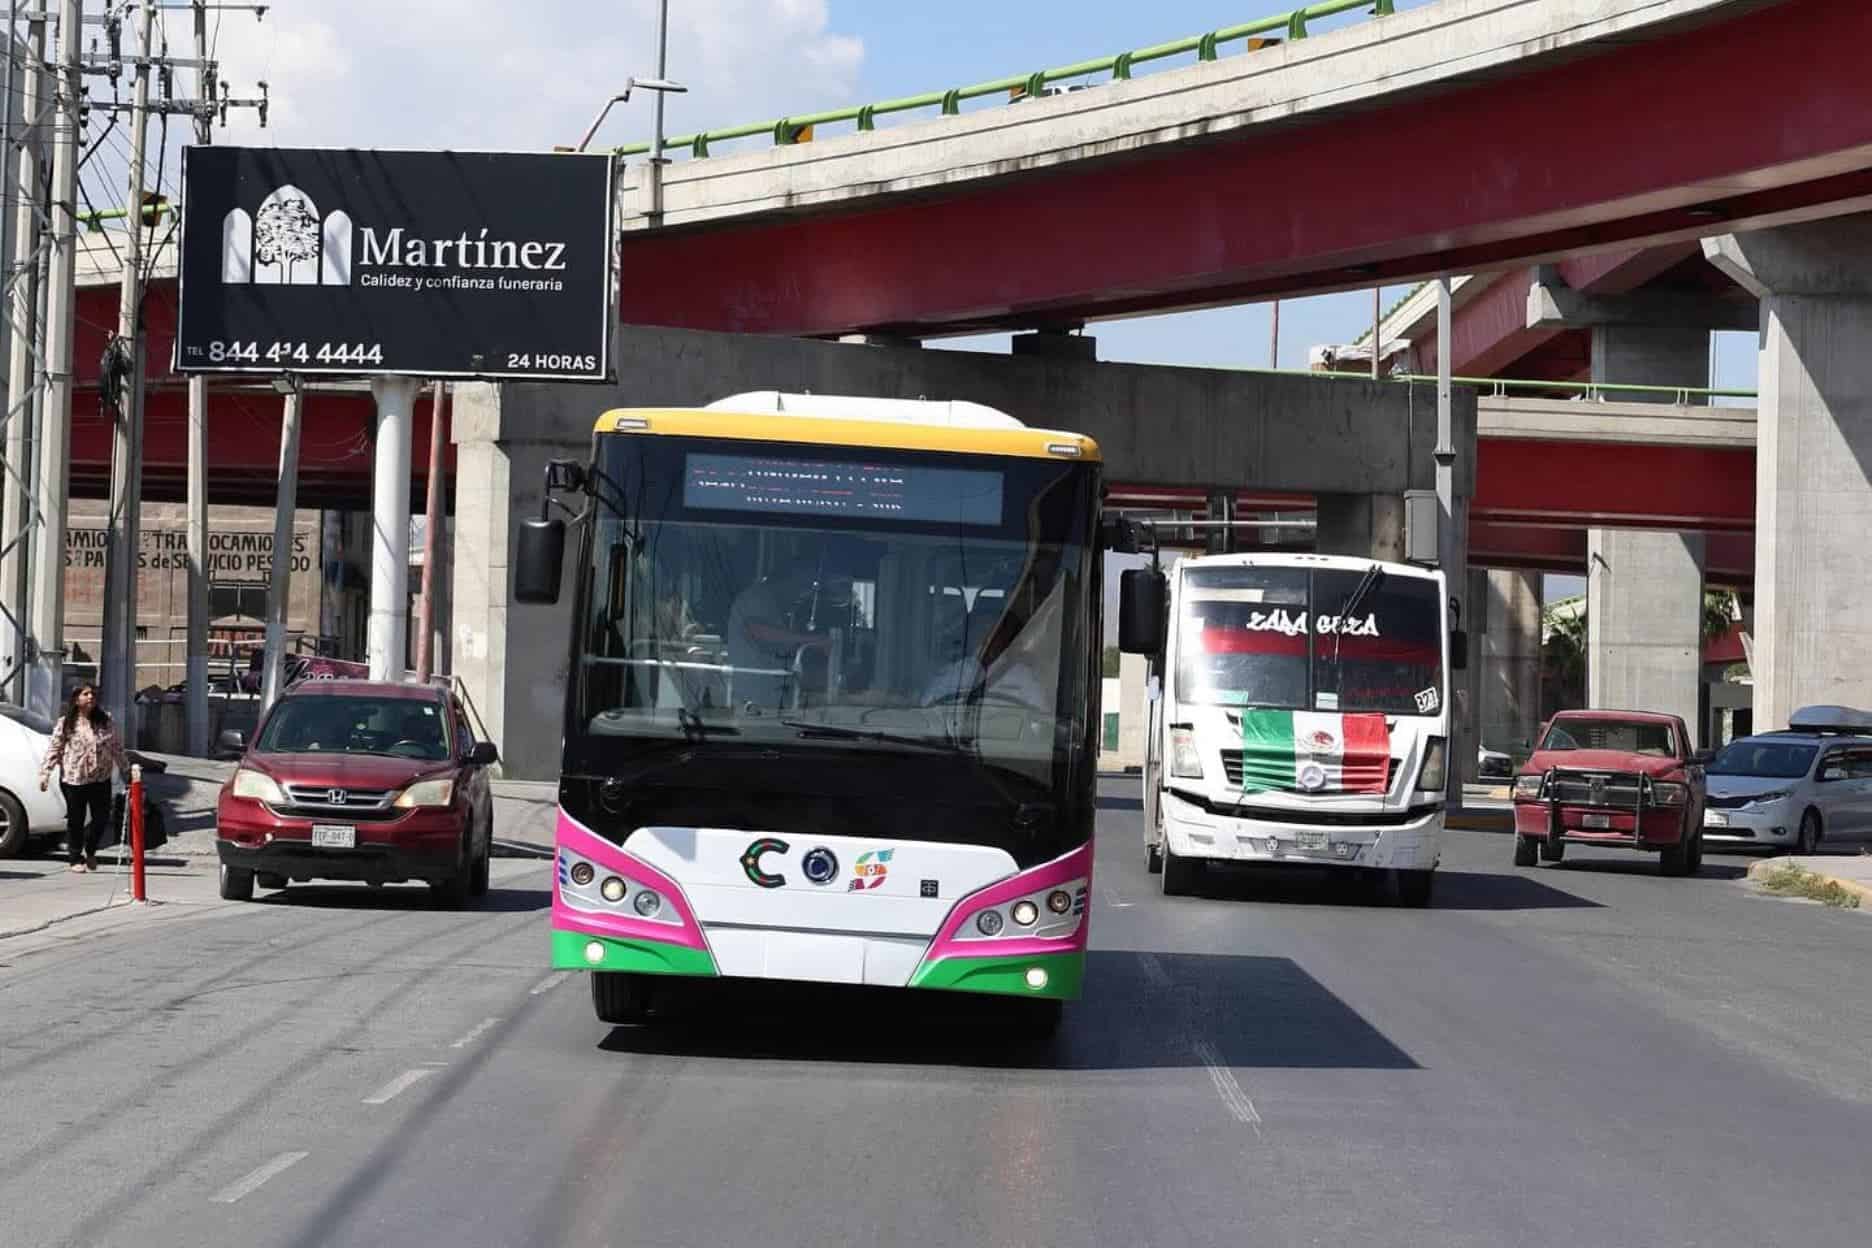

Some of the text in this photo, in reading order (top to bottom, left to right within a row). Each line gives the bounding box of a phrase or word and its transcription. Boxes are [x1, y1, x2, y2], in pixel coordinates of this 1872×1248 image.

[359, 227, 566, 269] Martínez
[361, 273, 563, 291] Calidez y confianza funeraria
[186, 346, 203, 355] TEL
[209, 341, 259, 362] 844
[316, 343, 384, 364] 4444
[508, 354, 596, 370] 24 HORAS
[152, 533, 305, 552] TRAOCAMIOS
[151, 553, 171, 568] de
[173, 553, 242, 570] SEVICIO
[247, 555, 310, 572] PESDO
